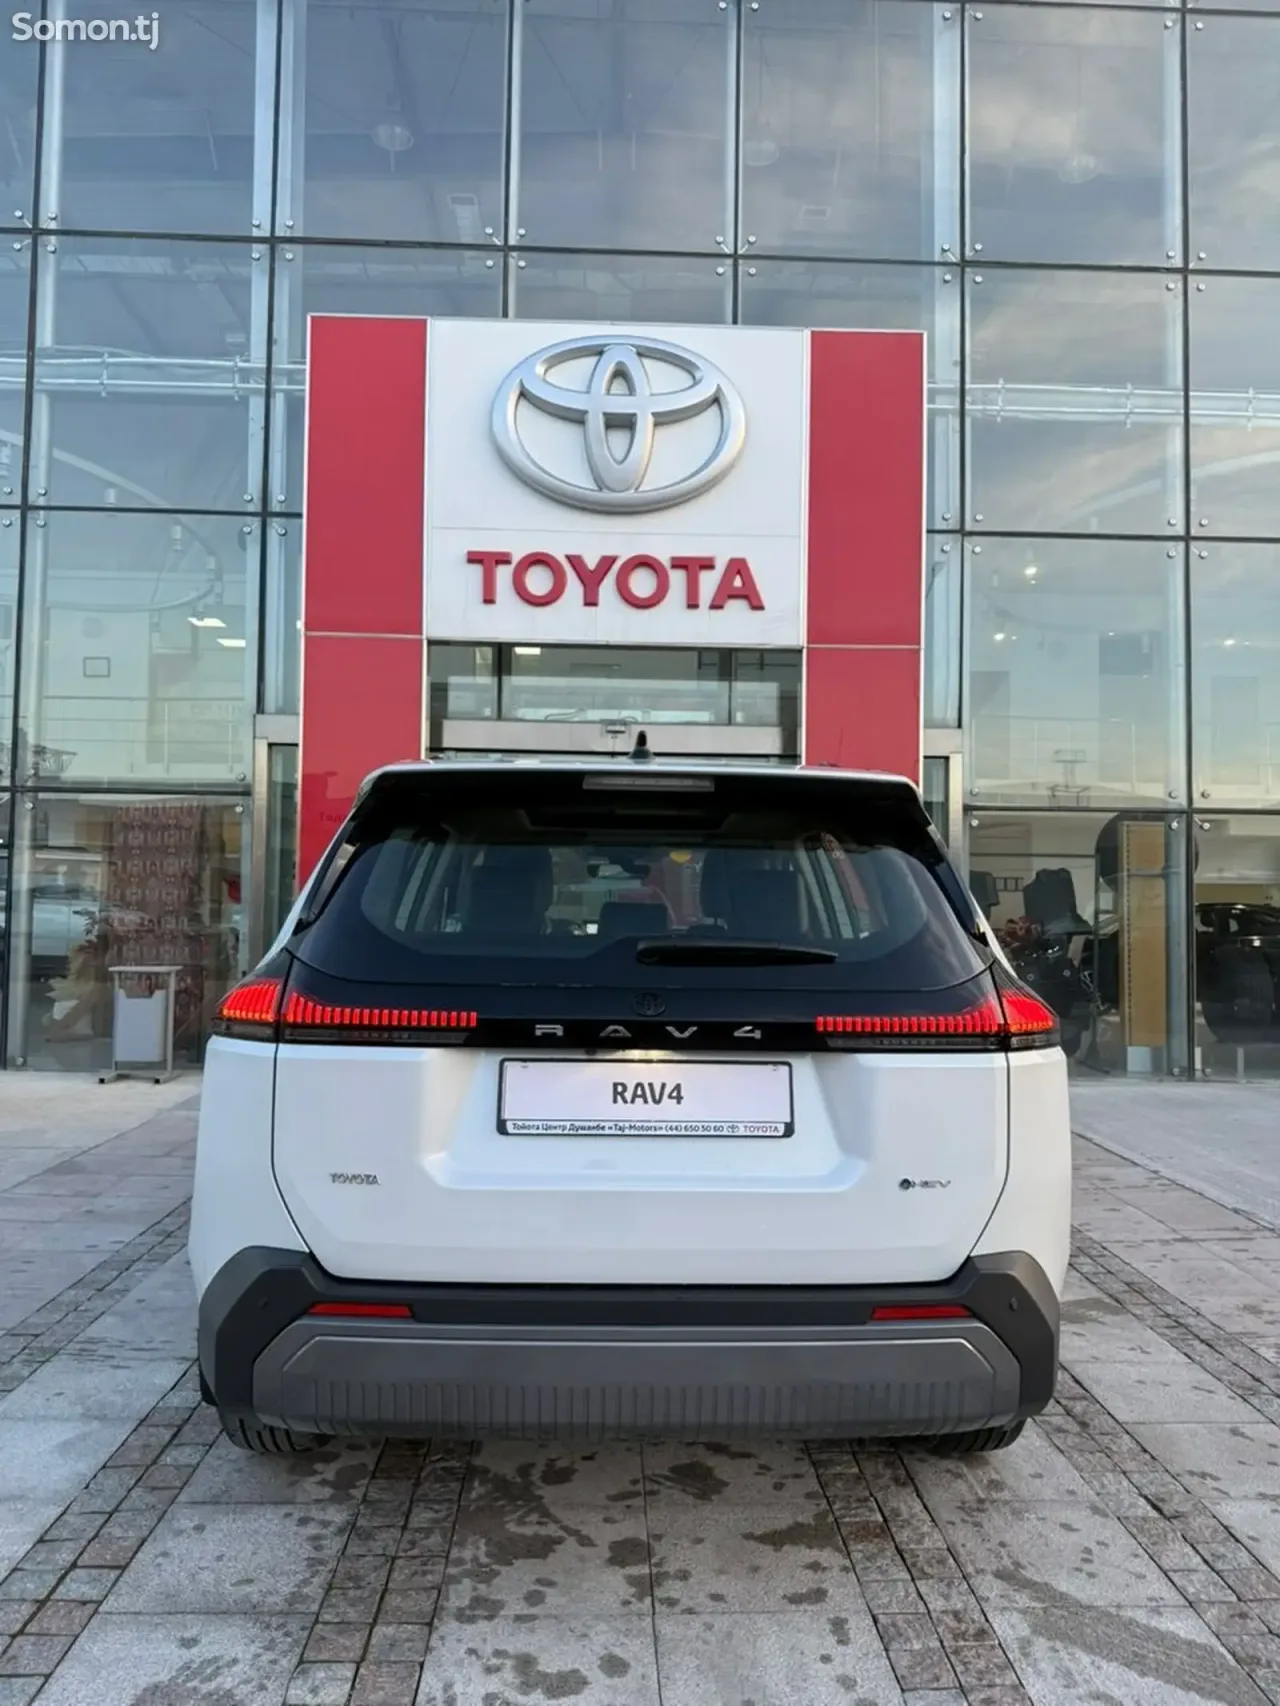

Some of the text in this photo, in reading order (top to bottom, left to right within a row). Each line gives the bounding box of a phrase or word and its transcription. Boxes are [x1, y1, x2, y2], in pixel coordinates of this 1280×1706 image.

[466, 550, 766, 611] TOYOTA
[534, 1023, 763, 1040] RAV4
[611, 1081, 685, 1106] RAV4
[743, 1124, 780, 1134] TOYOTA
[329, 1172, 381, 1186] TOYOTA
